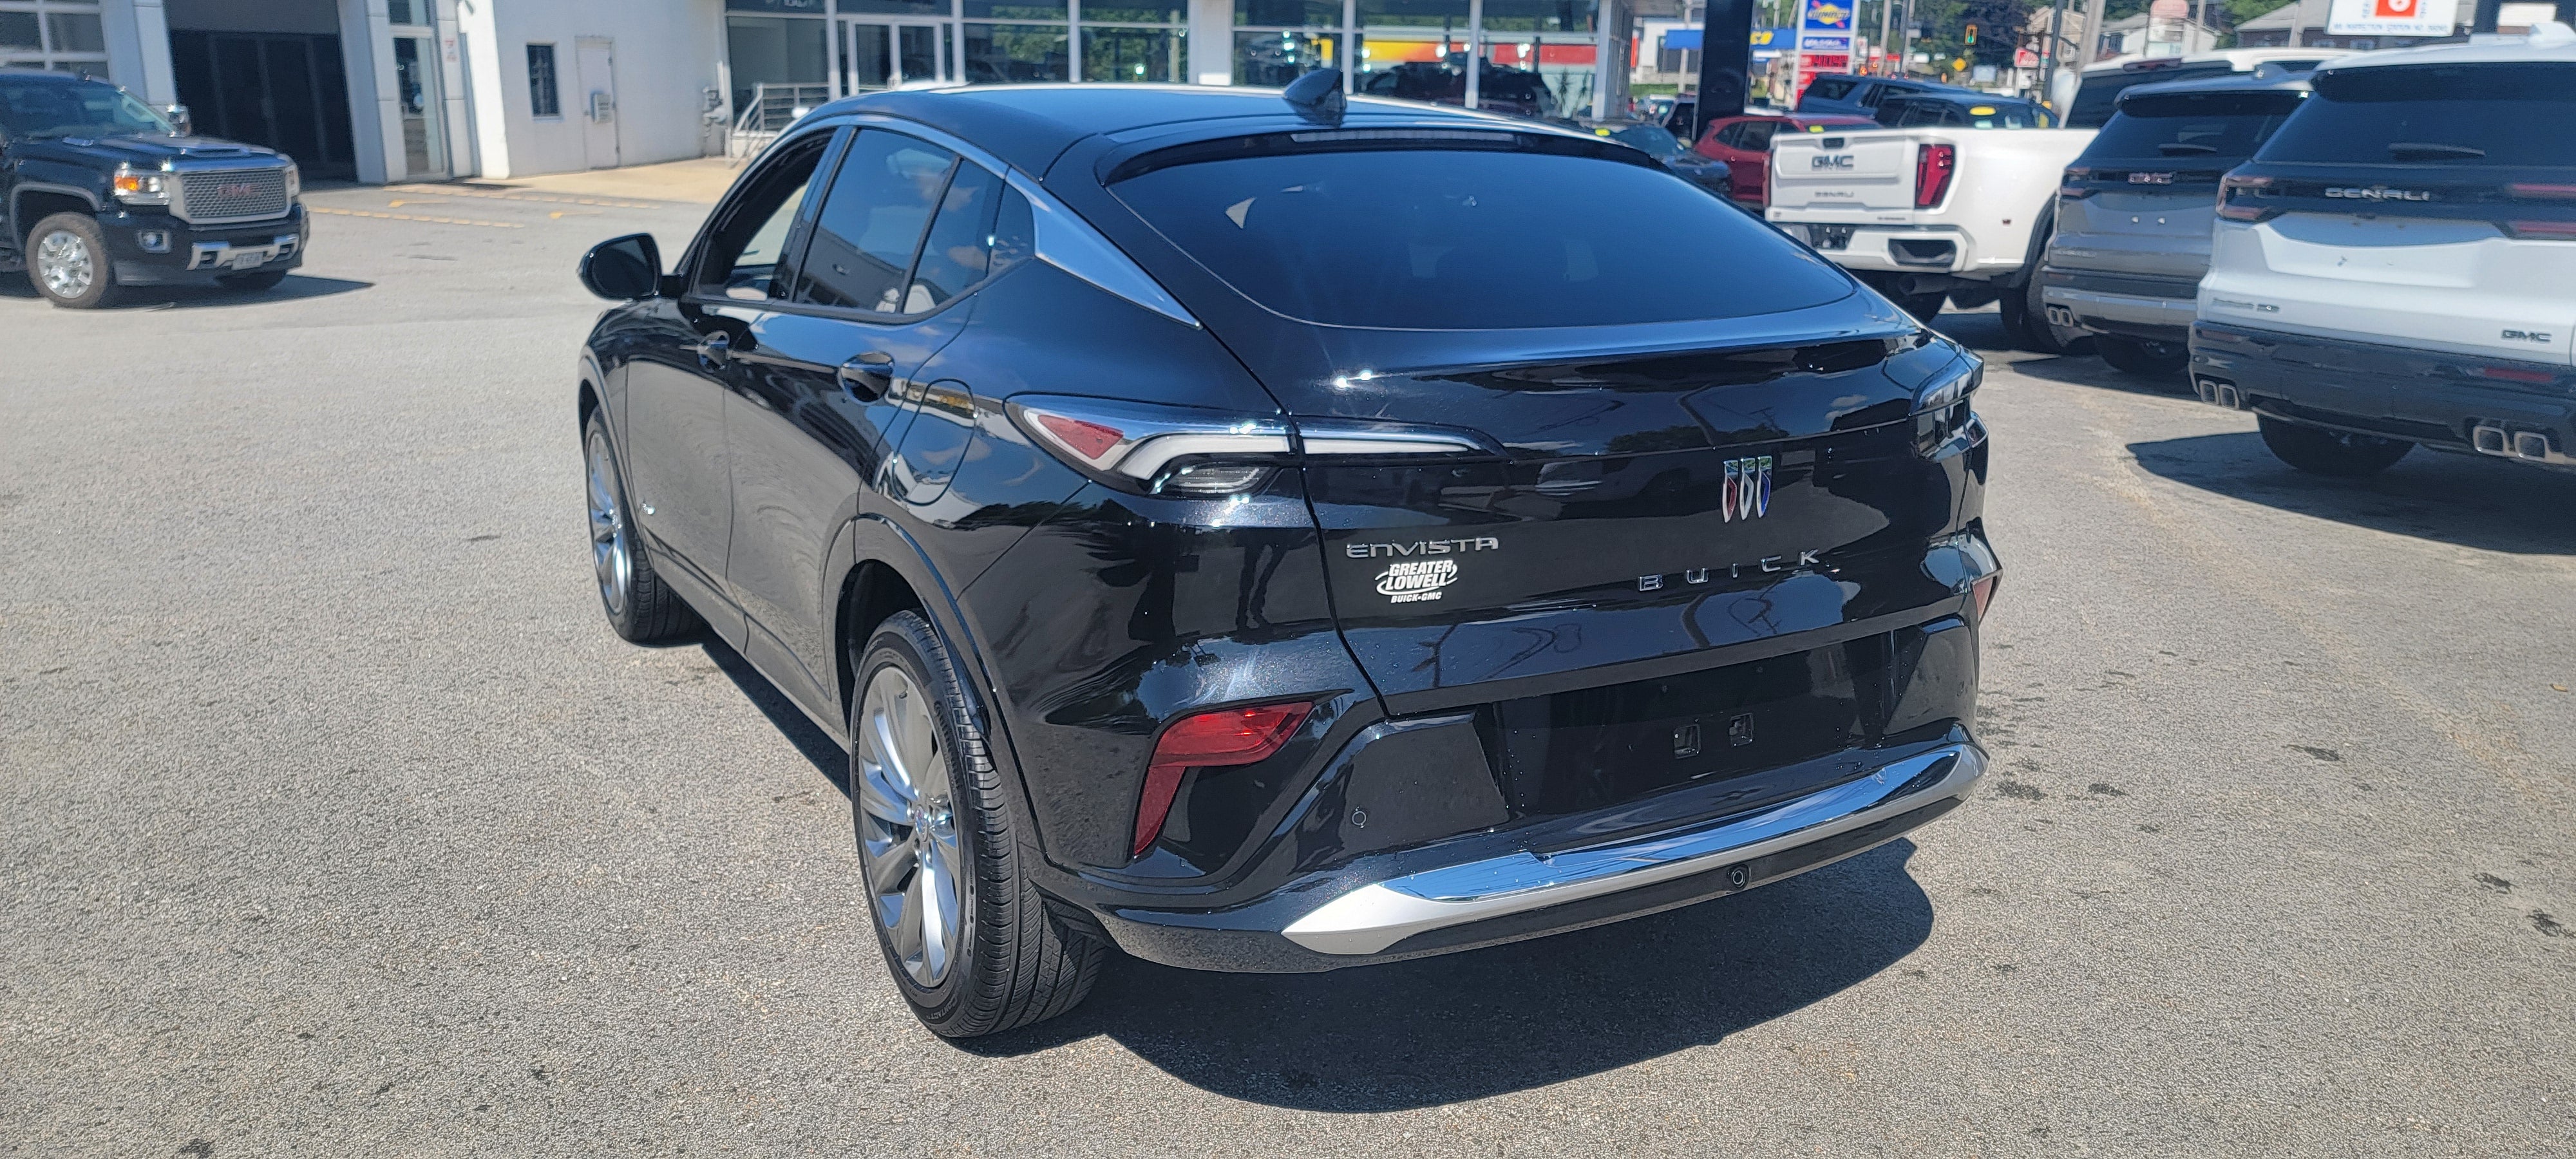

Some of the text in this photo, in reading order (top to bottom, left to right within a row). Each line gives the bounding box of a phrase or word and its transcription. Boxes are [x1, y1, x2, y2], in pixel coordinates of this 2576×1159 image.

[1812, 155, 1854, 169] GMC
[2325, 188, 2430, 201] DENALI
[2502, 330, 2552, 343] GMC
[1346, 537, 1499, 558] ENVISTA
[1388, 560, 1454, 577] GREATER
[1639, 549, 1820, 591] BUICK
[1385, 572, 1447, 590] LOWELL
